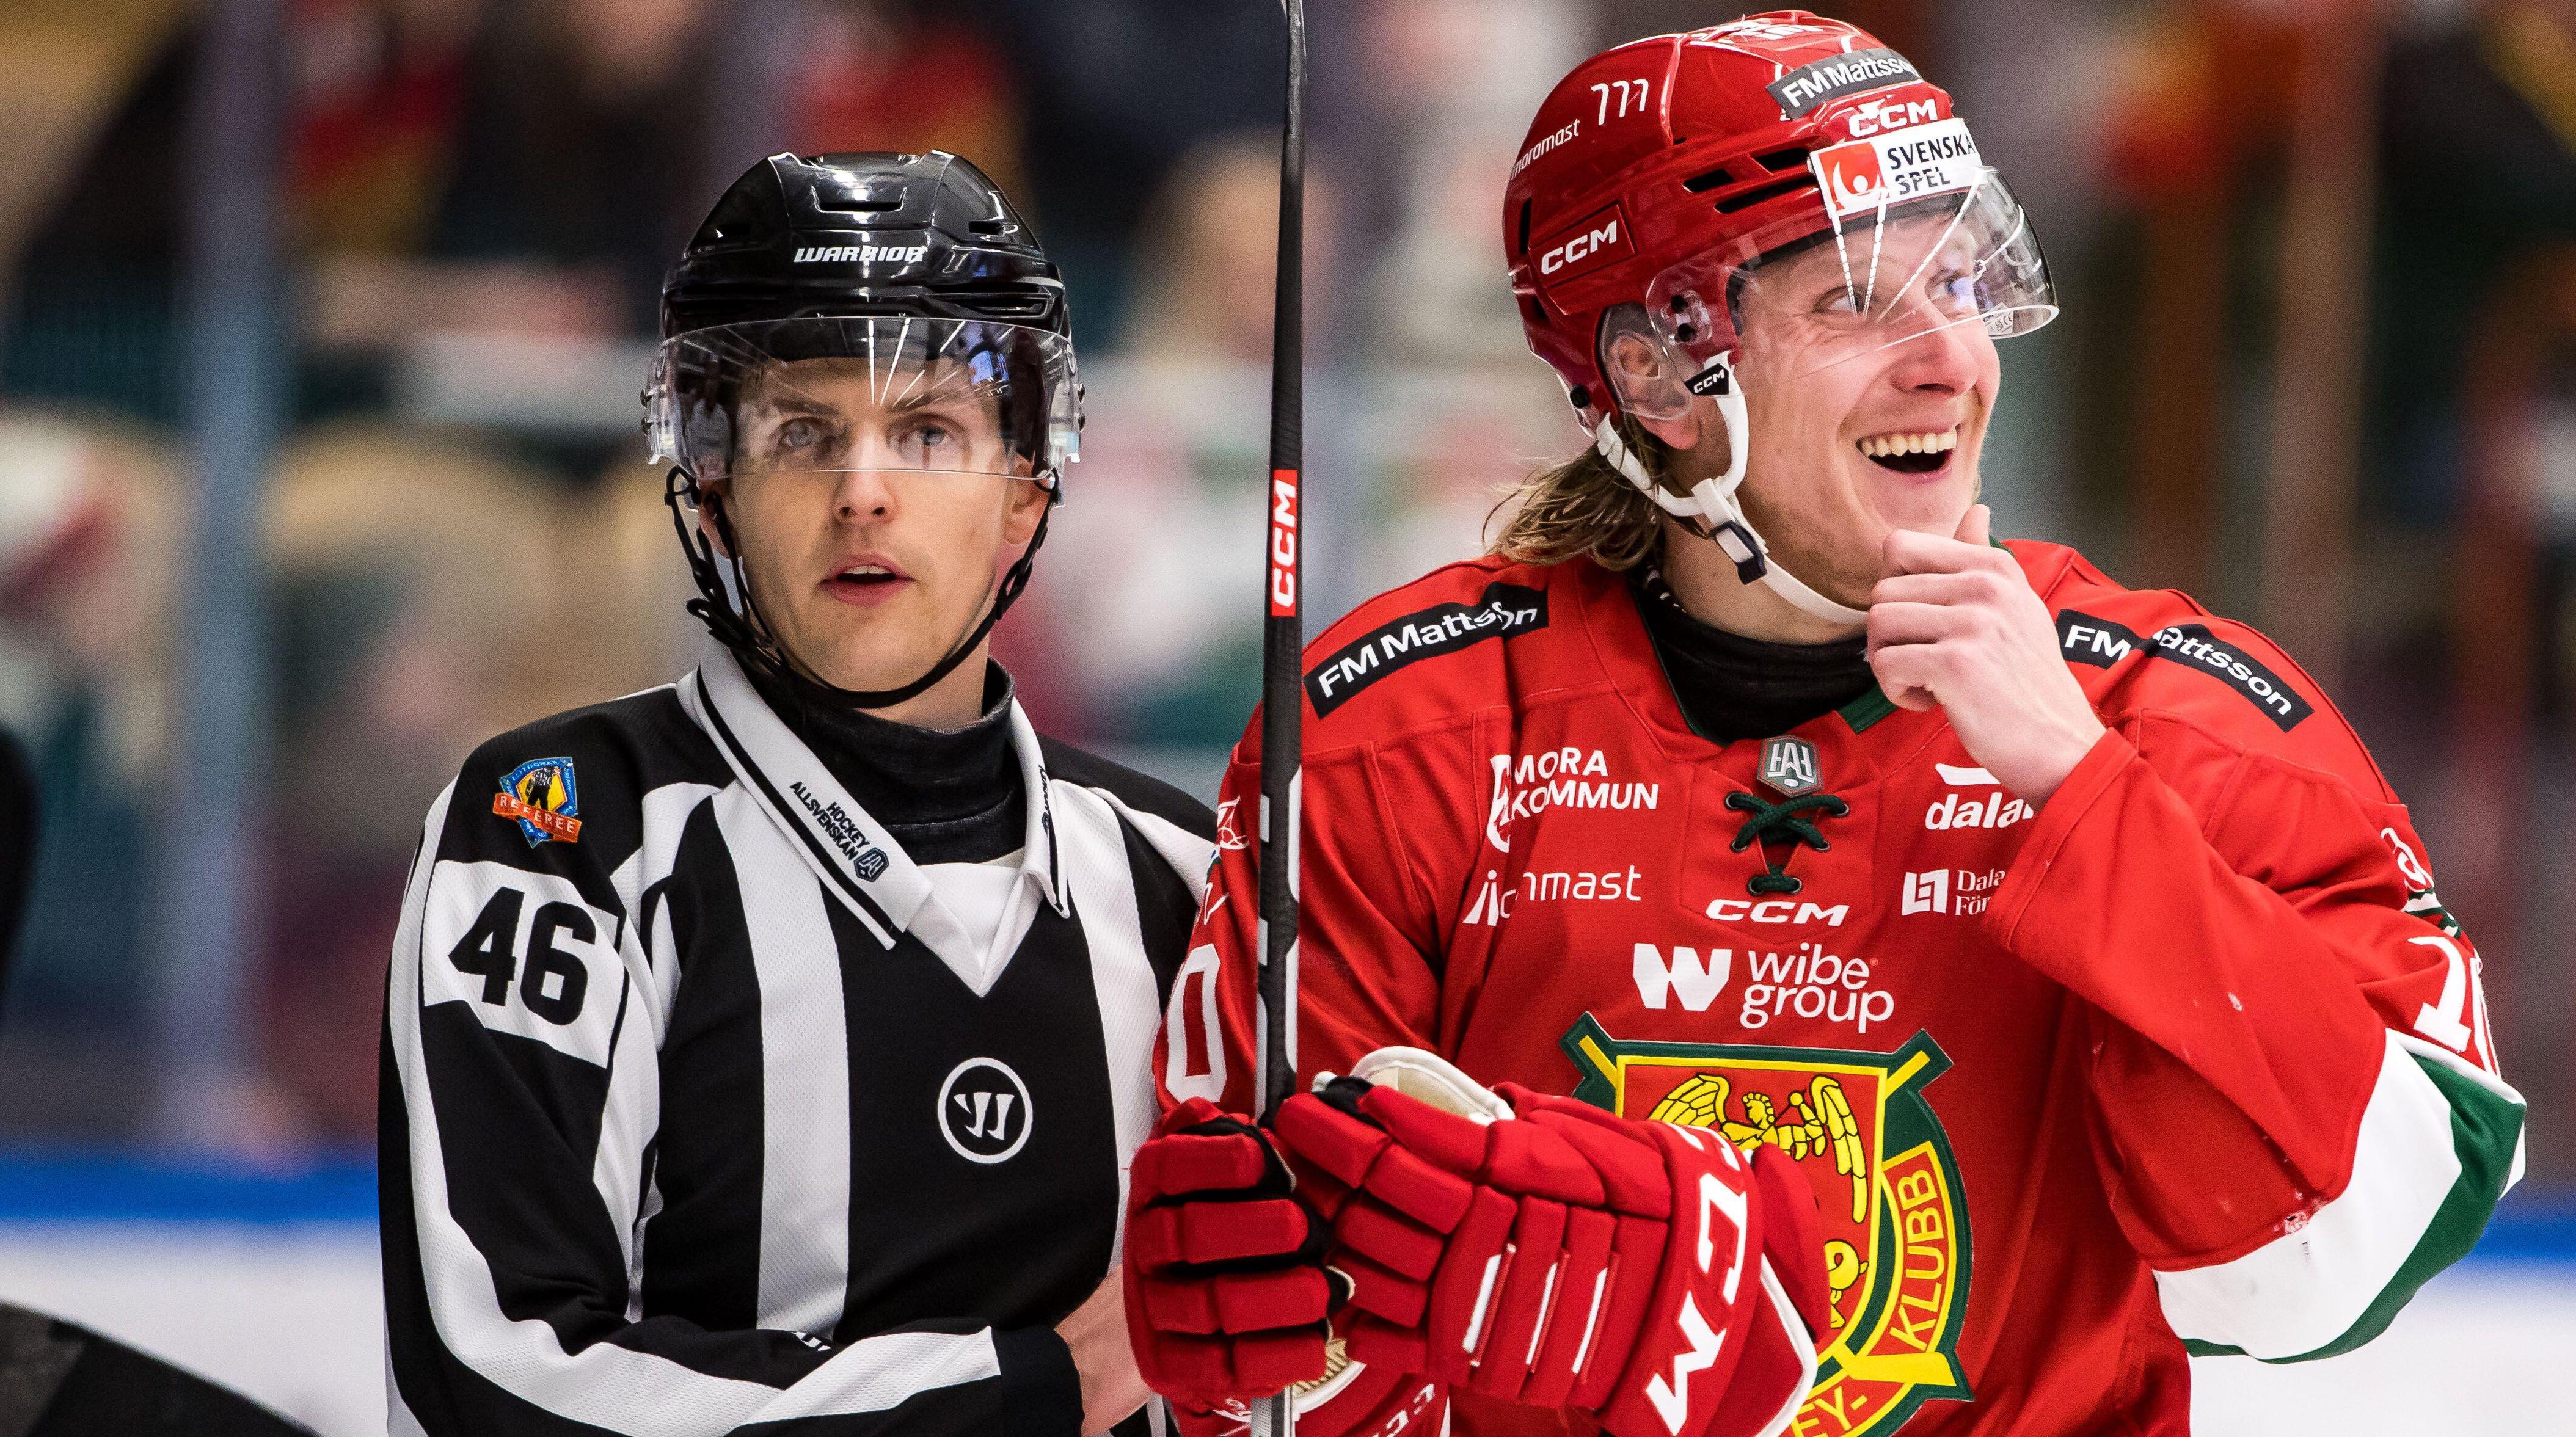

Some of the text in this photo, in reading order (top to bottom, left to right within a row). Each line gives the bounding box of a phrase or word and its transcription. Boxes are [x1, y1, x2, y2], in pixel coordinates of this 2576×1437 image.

[1782, 58, 1920, 107] FM Mattsso
[1848, 99, 1938, 137] CCM
[1887, 133, 1976, 170] SVENSKA
[1894, 167, 1950, 195] SPEL
[794, 246, 927, 263] WARRIOR
[1541, 220, 1617, 275] CCM
[1693, 369, 1725, 393] CCM
[1274, 479, 1296, 608] CCM
[1318, 644, 1380, 698] FM
[2065, 625, 2293, 716] FM attsson
[1514, 746, 1608, 784] MORA
[500, 795, 576, 834] REFEREE
[789, 781, 859, 861] ALLSVENSKAN
[1511, 780, 1659, 818] KOMMUN
[826, 801, 870, 849] HOCKEY
[1705, 898, 1850, 926] CCM
[448, 886, 597, 1026] 46
[1747, 942, 1870, 990] wibe
[1739, 984, 1894, 1033] group
[1889, 1169, 1945, 1353] KLUBB
